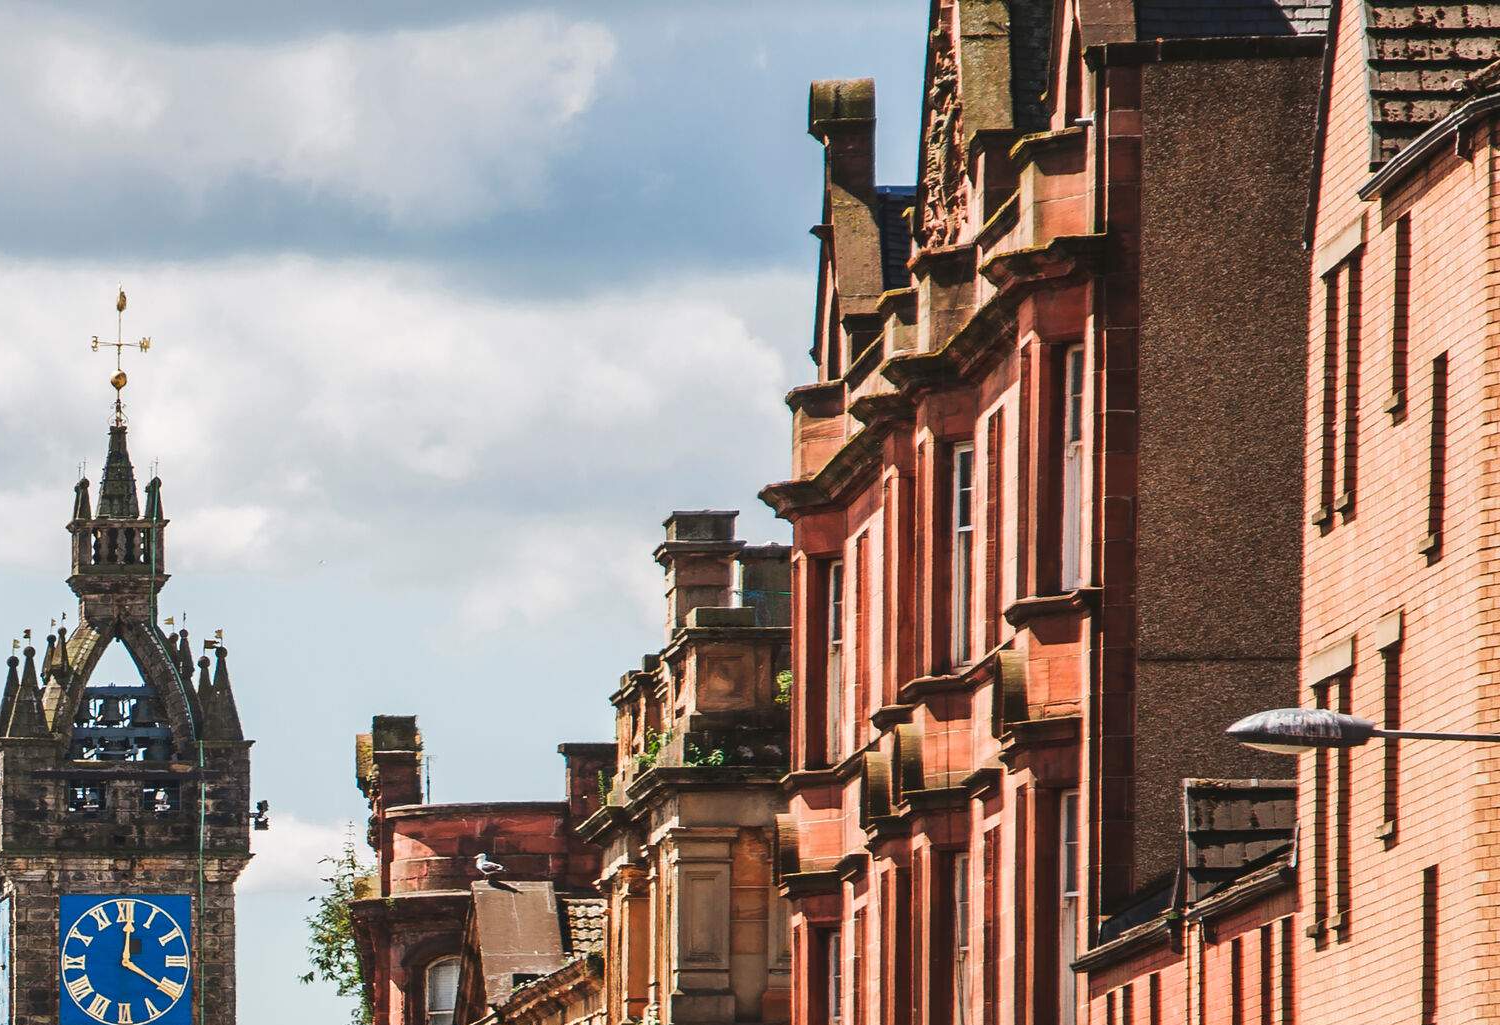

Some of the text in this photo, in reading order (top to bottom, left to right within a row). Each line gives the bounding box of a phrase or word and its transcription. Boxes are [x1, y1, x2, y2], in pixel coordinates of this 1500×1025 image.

[89, 907, 112, 931] XI
[116, 901, 135, 923] XII
[143, 907, 160, 929] I
[70, 927, 94, 947] X
[158, 927, 181, 946] II
[64, 954, 86, 970] IX
[165, 955, 188, 968] III
[68, 974, 94, 1002] VIII
[87, 993, 112, 1020] VII
[117, 1003, 133, 1024] VI
[144, 997, 162, 1018] V
